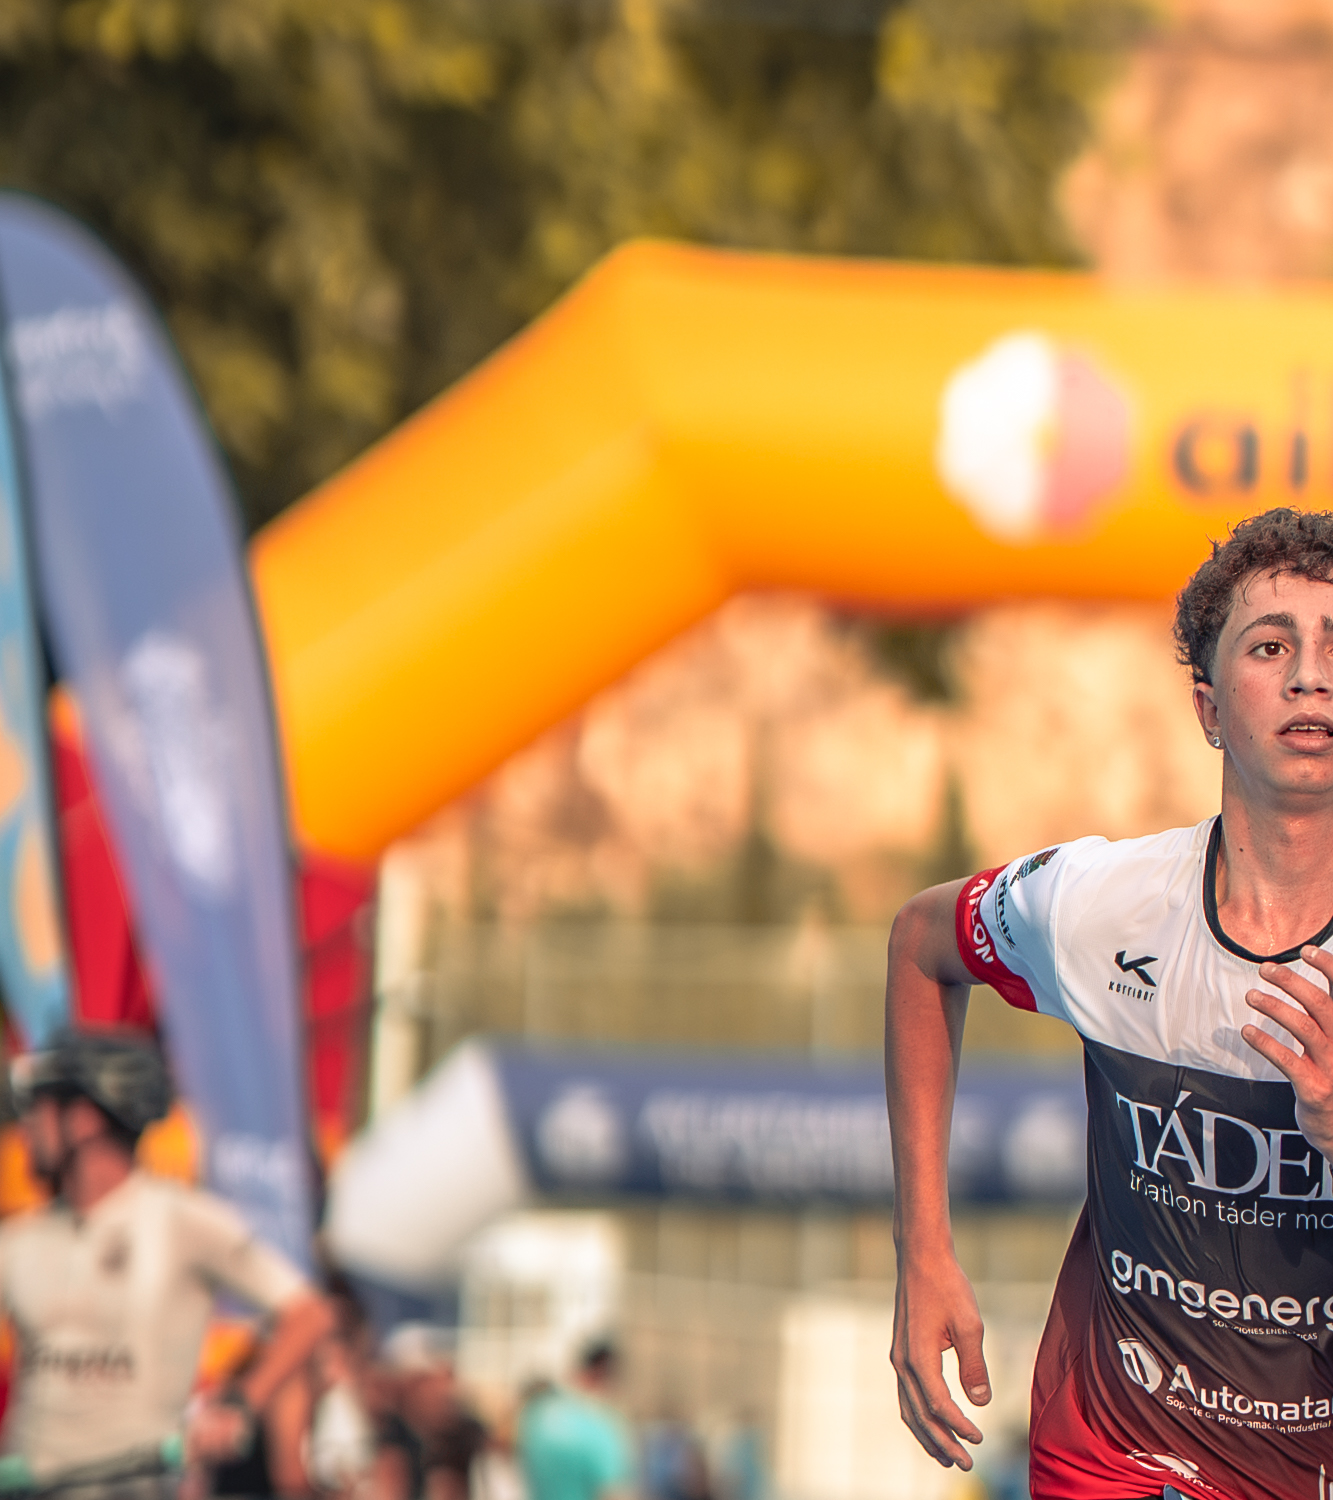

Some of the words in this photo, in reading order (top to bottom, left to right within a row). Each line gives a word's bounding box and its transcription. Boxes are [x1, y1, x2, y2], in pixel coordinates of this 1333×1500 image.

[1130, 1169, 1207, 1218] triatlon
[1215, 1201, 1287, 1229] táder
[1287, 1419, 1332, 1434] Industrial
